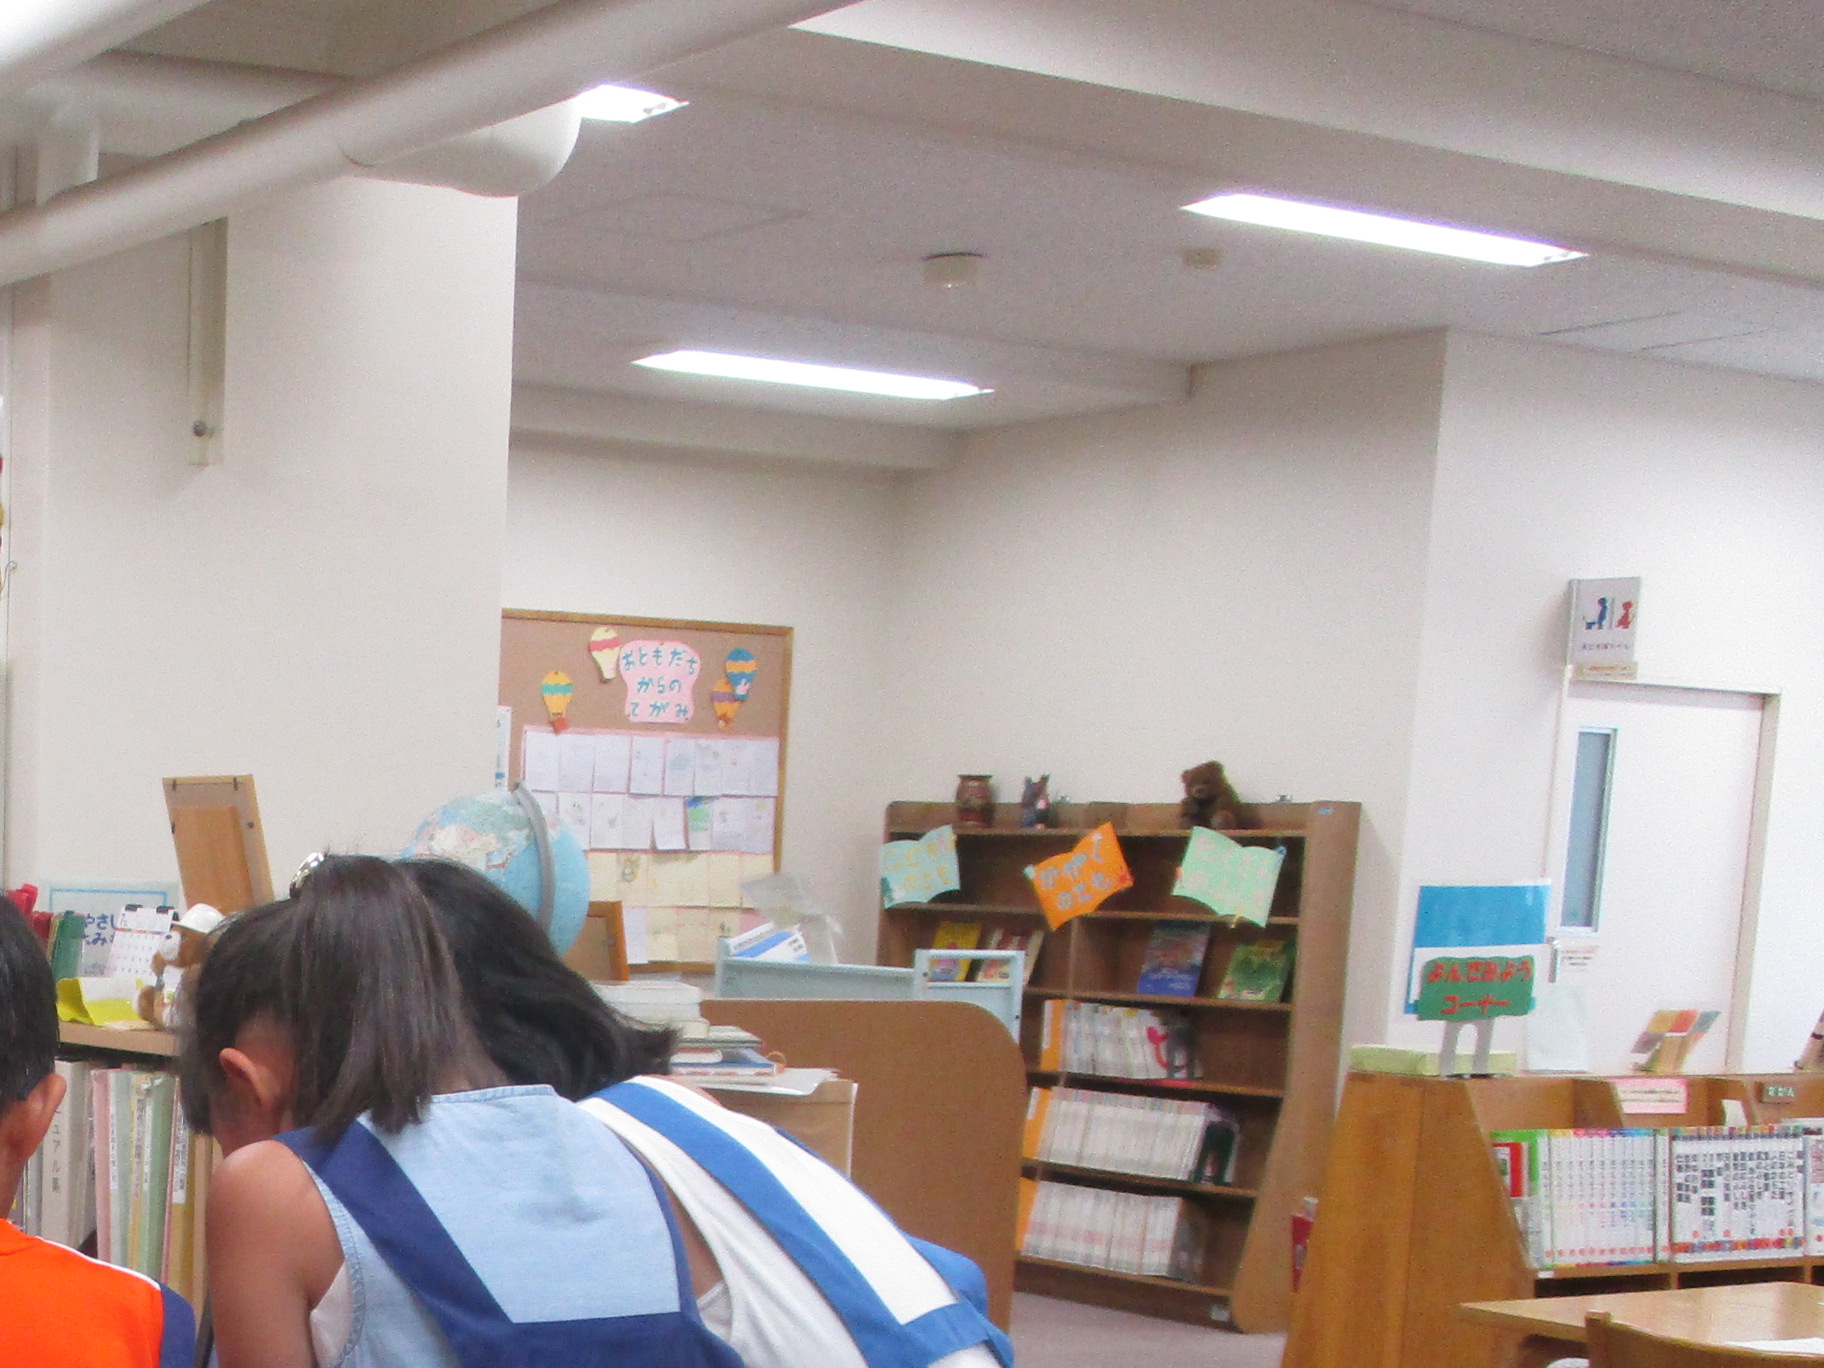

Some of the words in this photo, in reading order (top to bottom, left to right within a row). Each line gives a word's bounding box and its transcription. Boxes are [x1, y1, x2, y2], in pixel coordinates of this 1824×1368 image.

[622, 647, 699, 675] おともだち
[630, 701, 689, 718] てがみ
[1428, 959, 1532, 983] よんでみよう
[1440, 994, 1513, 1014] コーナー
